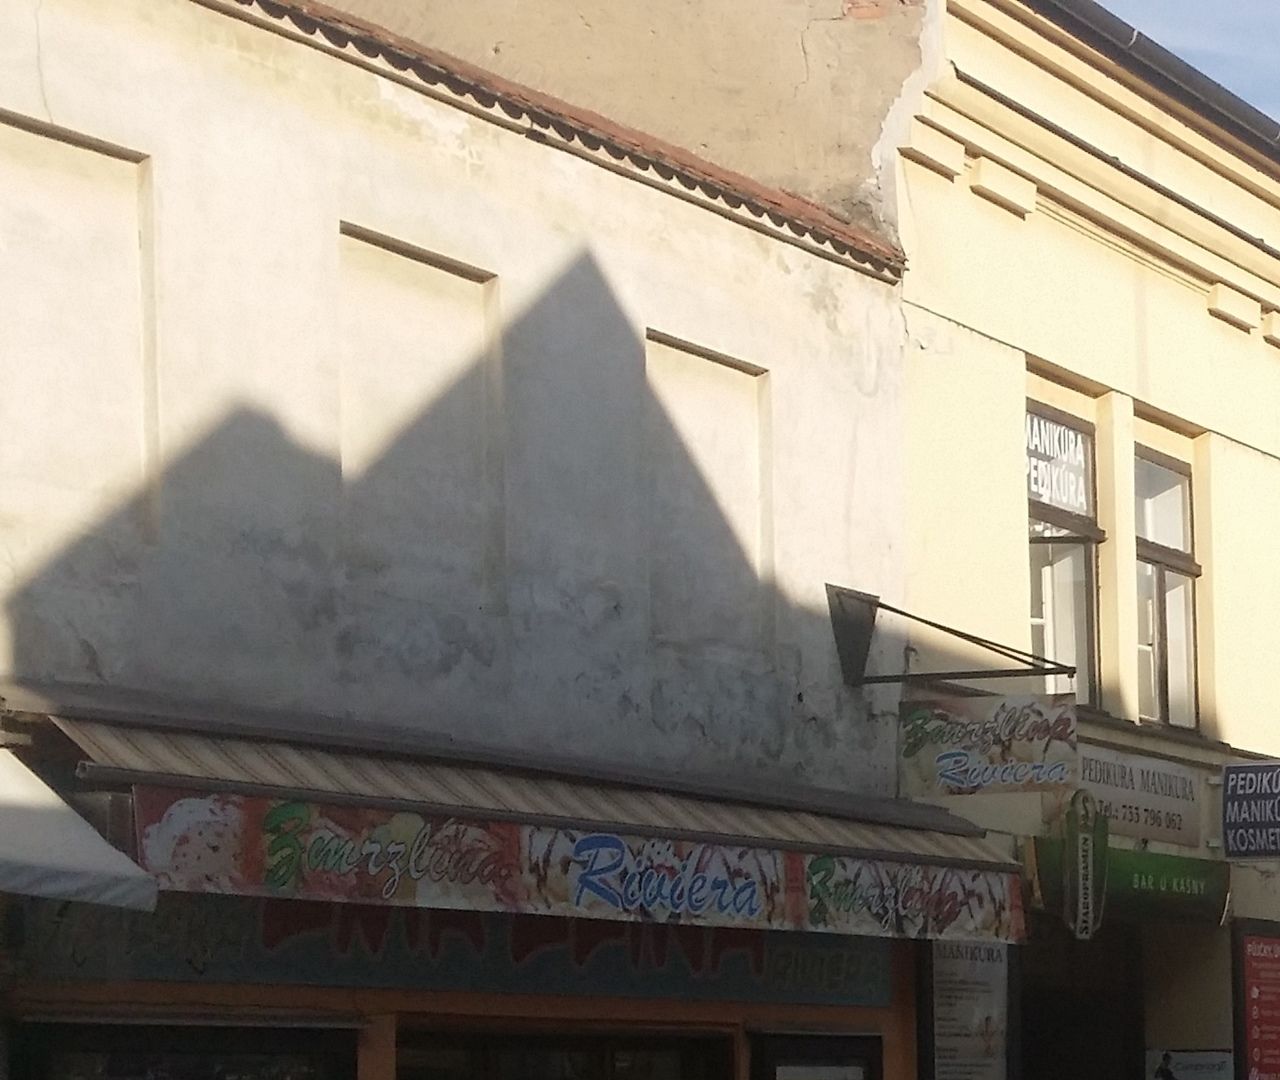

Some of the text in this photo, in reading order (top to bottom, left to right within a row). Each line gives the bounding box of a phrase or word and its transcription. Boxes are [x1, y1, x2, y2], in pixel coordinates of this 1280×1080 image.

[902, 706, 1073, 758] Zmrzlina
[935, 751, 1069, 789] Riviera
[264, 801, 512, 899] Zmrzlina
[573, 832, 761, 918] Riviera
